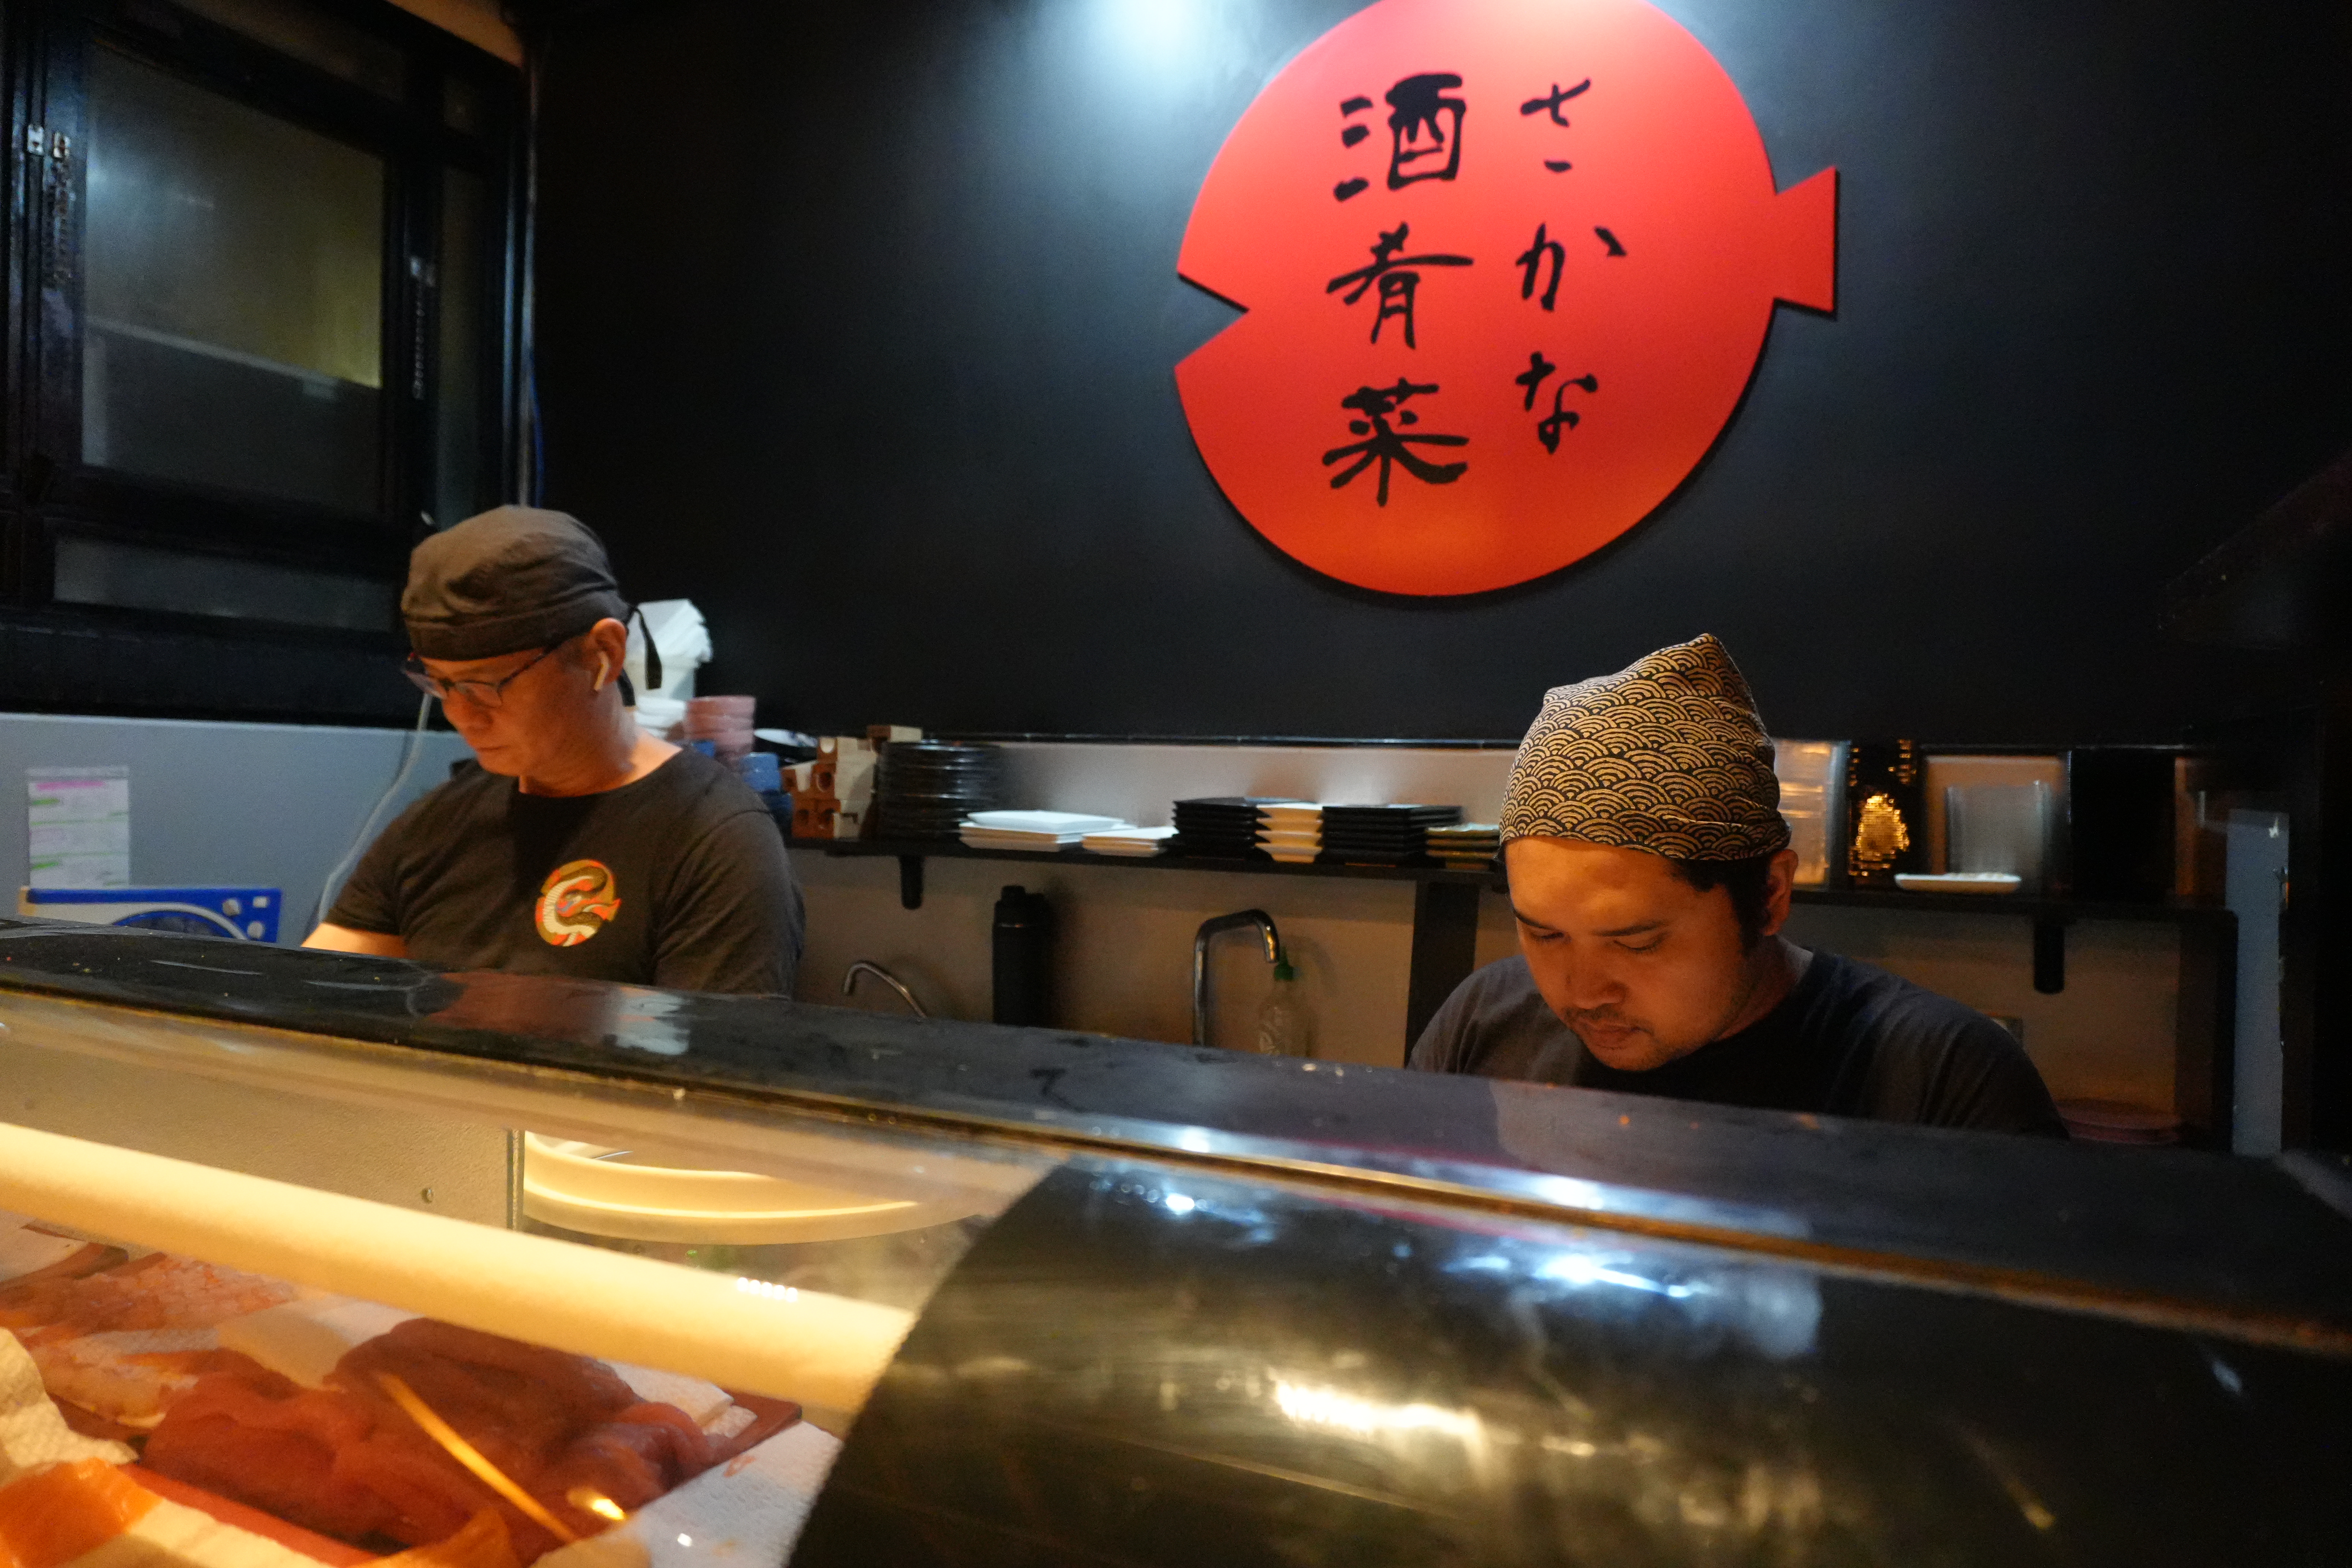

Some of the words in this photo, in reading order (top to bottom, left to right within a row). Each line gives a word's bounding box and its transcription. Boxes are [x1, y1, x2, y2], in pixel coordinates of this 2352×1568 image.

[1323, 73, 1475, 507] 酒肴菜
[1515, 79, 1627, 455] さかな
